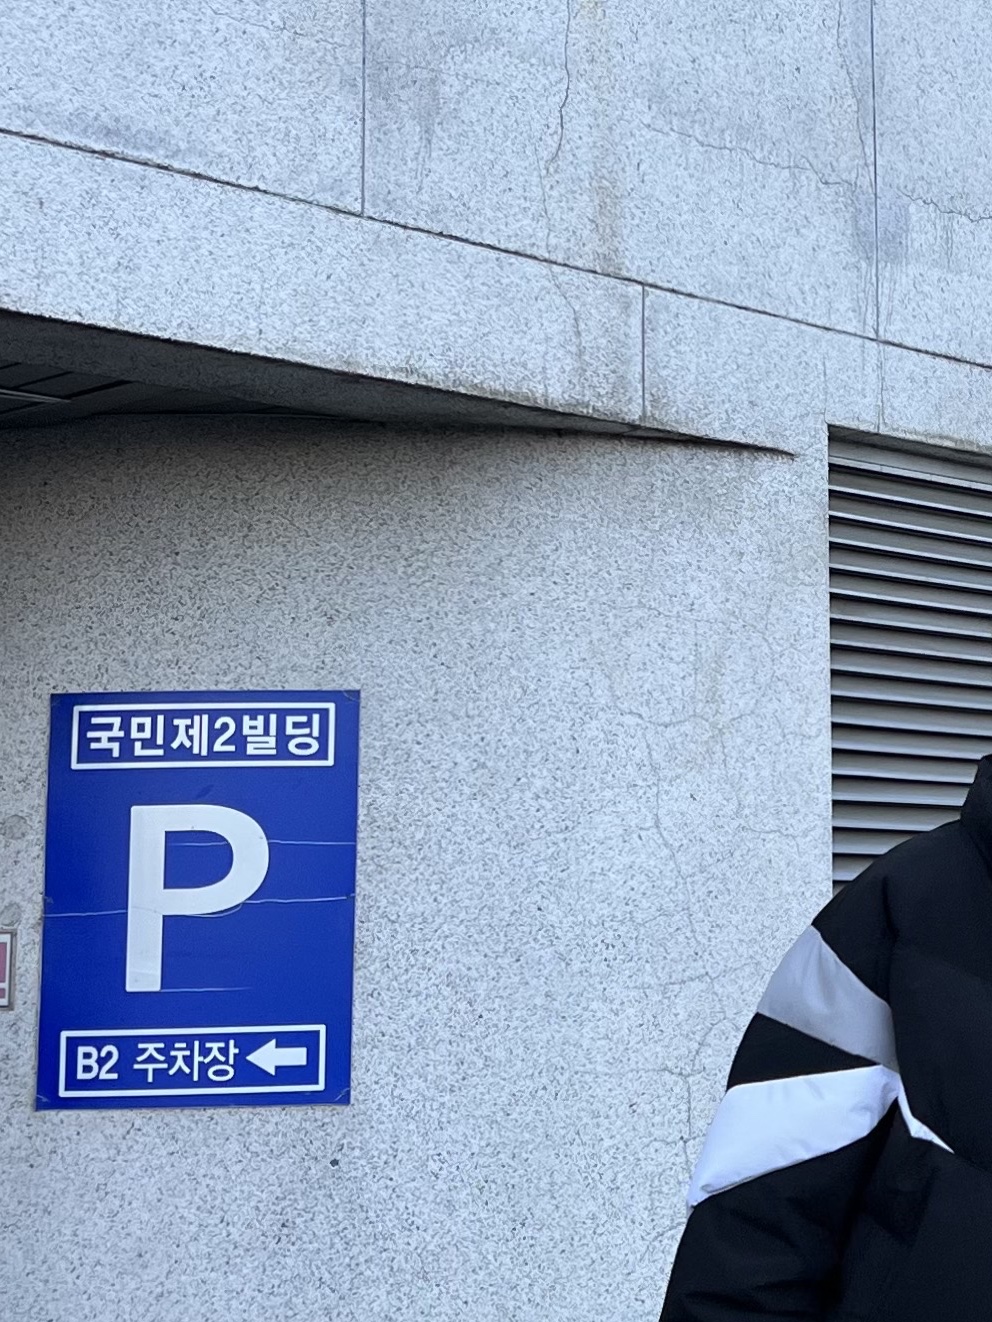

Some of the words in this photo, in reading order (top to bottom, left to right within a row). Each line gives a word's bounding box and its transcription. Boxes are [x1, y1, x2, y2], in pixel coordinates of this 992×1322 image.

[86, 713, 321, 758] 국민제2빌딩
[126, 804, 270, 993] P
[75, 1044, 120, 1081] B2
[132, 1040, 240, 1083] 주차장
